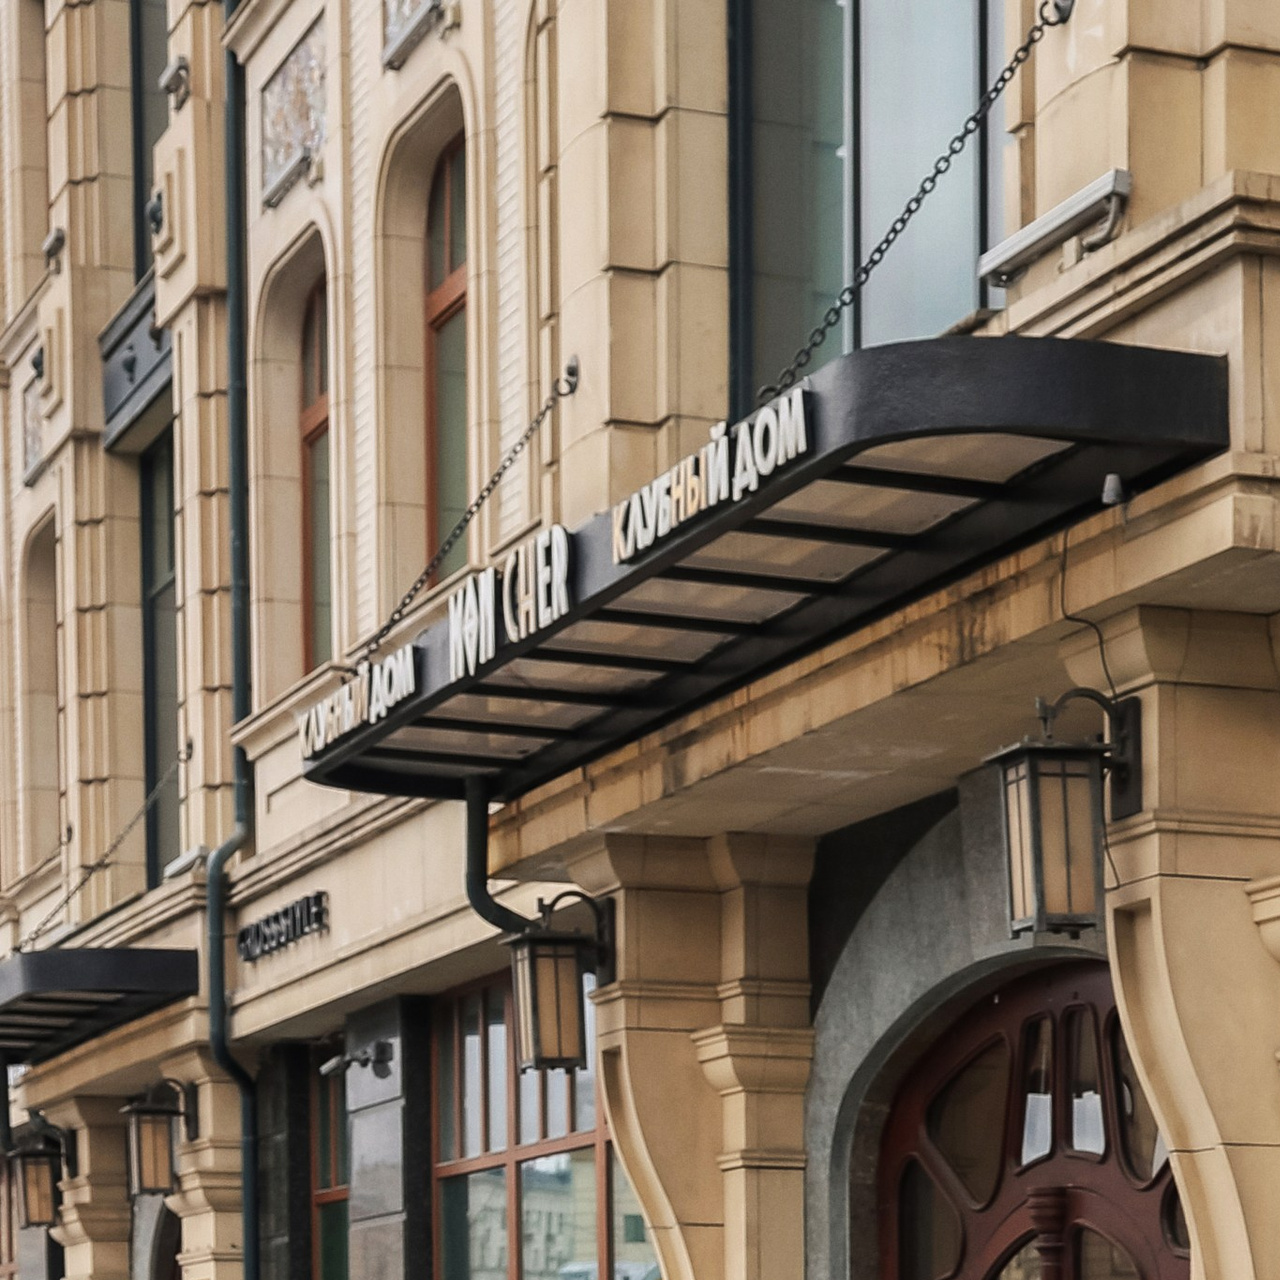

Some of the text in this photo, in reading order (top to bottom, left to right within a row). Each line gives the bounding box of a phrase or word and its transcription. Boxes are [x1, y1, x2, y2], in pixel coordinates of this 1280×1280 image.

[611, 387, 808, 565] КЛУБНЫЙ ДОМ
[502, 523, 570, 643] CHER
[369, 643, 416, 725] ДОМ
